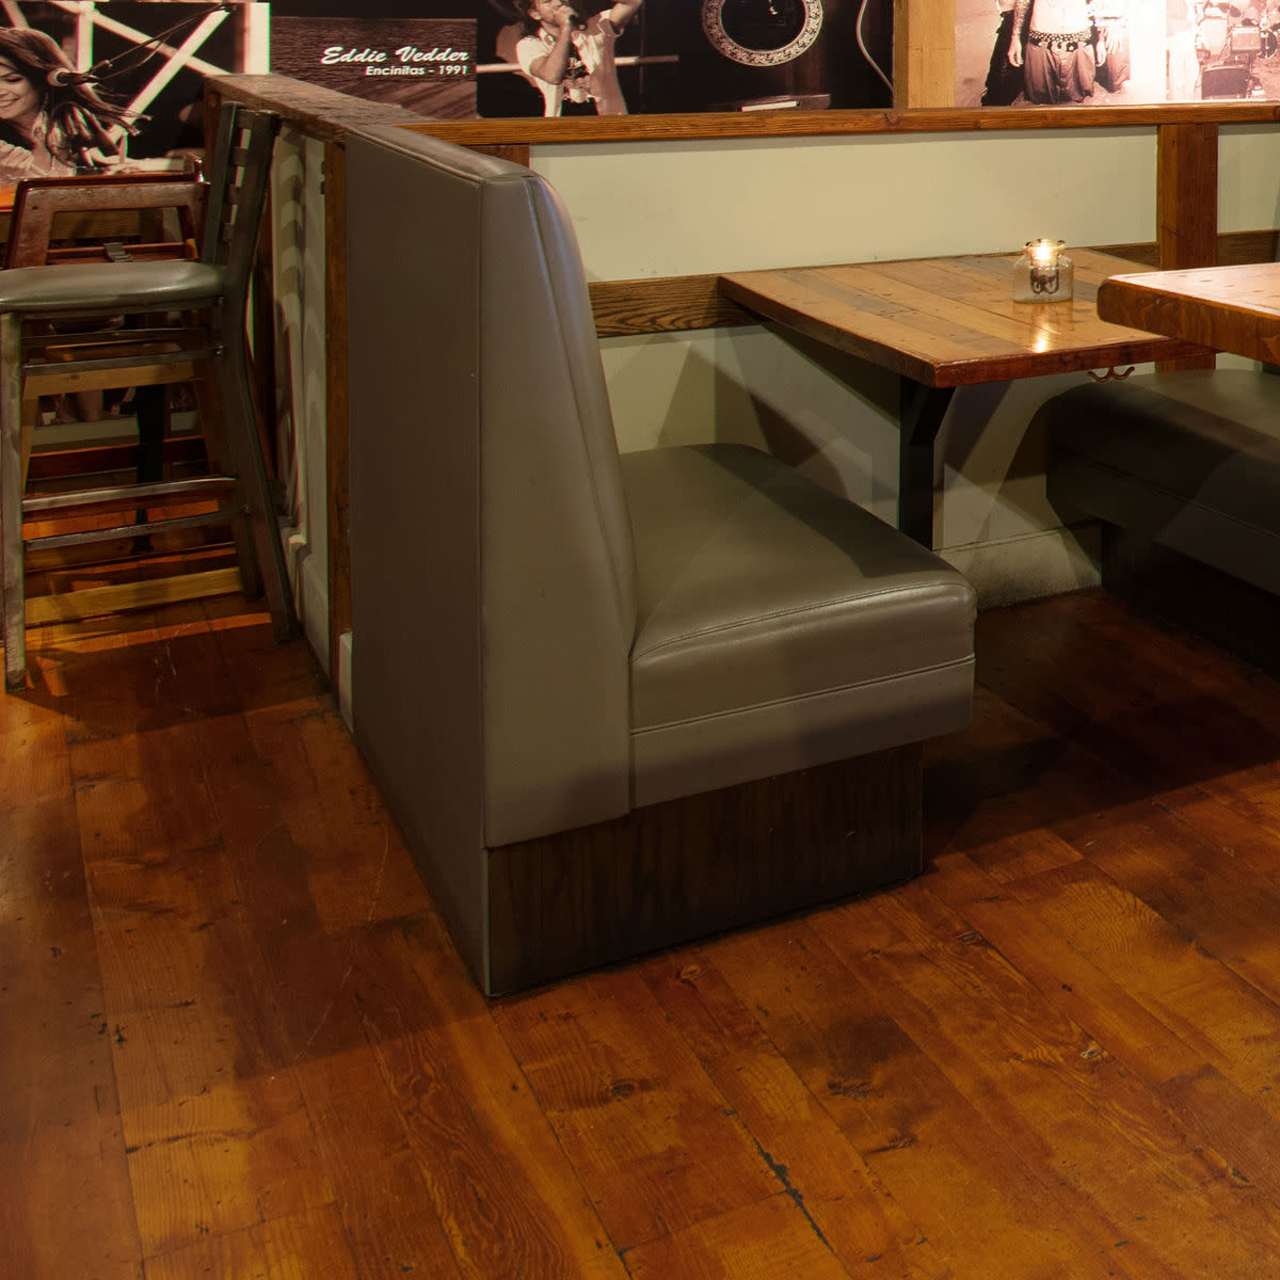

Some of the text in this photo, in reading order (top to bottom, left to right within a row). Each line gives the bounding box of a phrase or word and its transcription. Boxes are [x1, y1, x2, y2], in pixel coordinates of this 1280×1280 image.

[320, 46, 470, 64] Eddie Vedder
[365, 65, 425, 76] Encinitas
[439, 65, 467, 75] 1991
